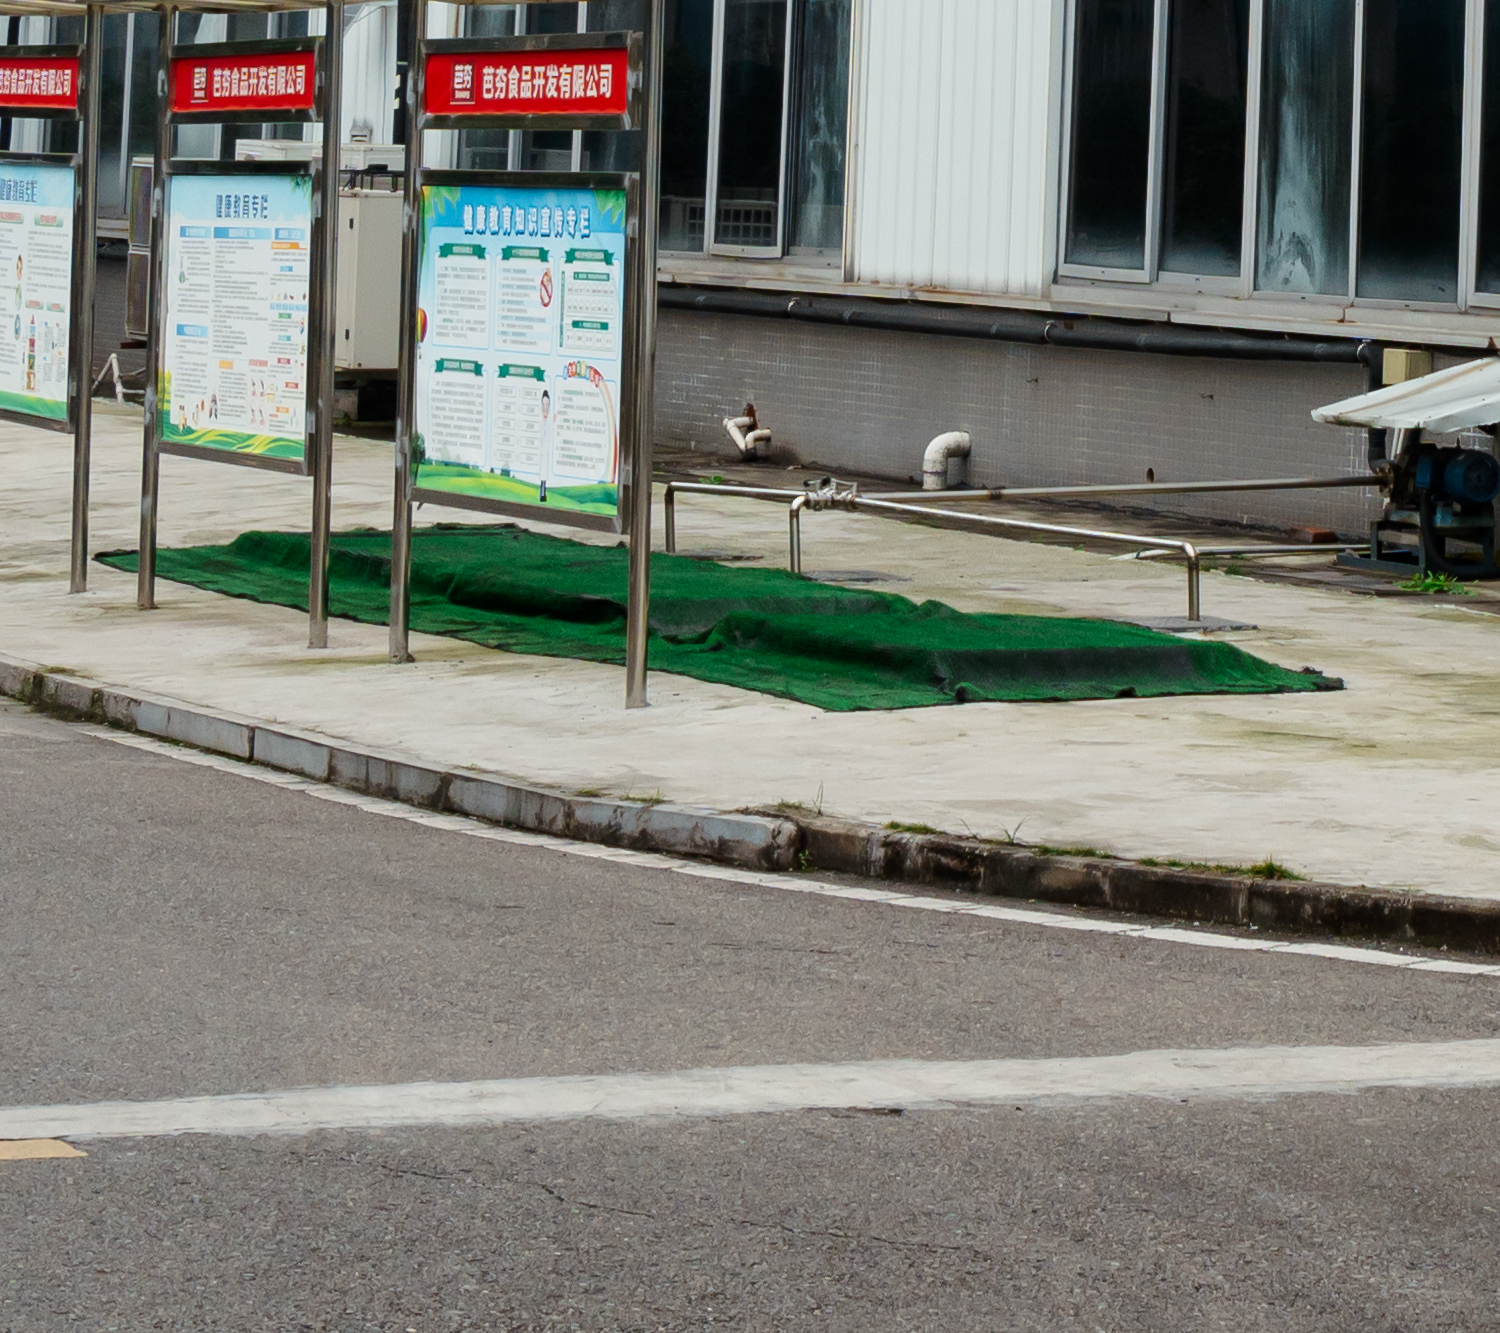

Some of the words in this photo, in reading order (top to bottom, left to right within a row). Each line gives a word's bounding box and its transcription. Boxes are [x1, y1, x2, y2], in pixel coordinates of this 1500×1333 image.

[213, 65, 306, 98] 芭夯食品开发有限公司
[482, 63, 613, 100] 芭夯食品开发有限公司
[215, 194, 269, 219] 健康教育专栏
[463, 204, 591, 239] 健康教育知识宣传专栏
